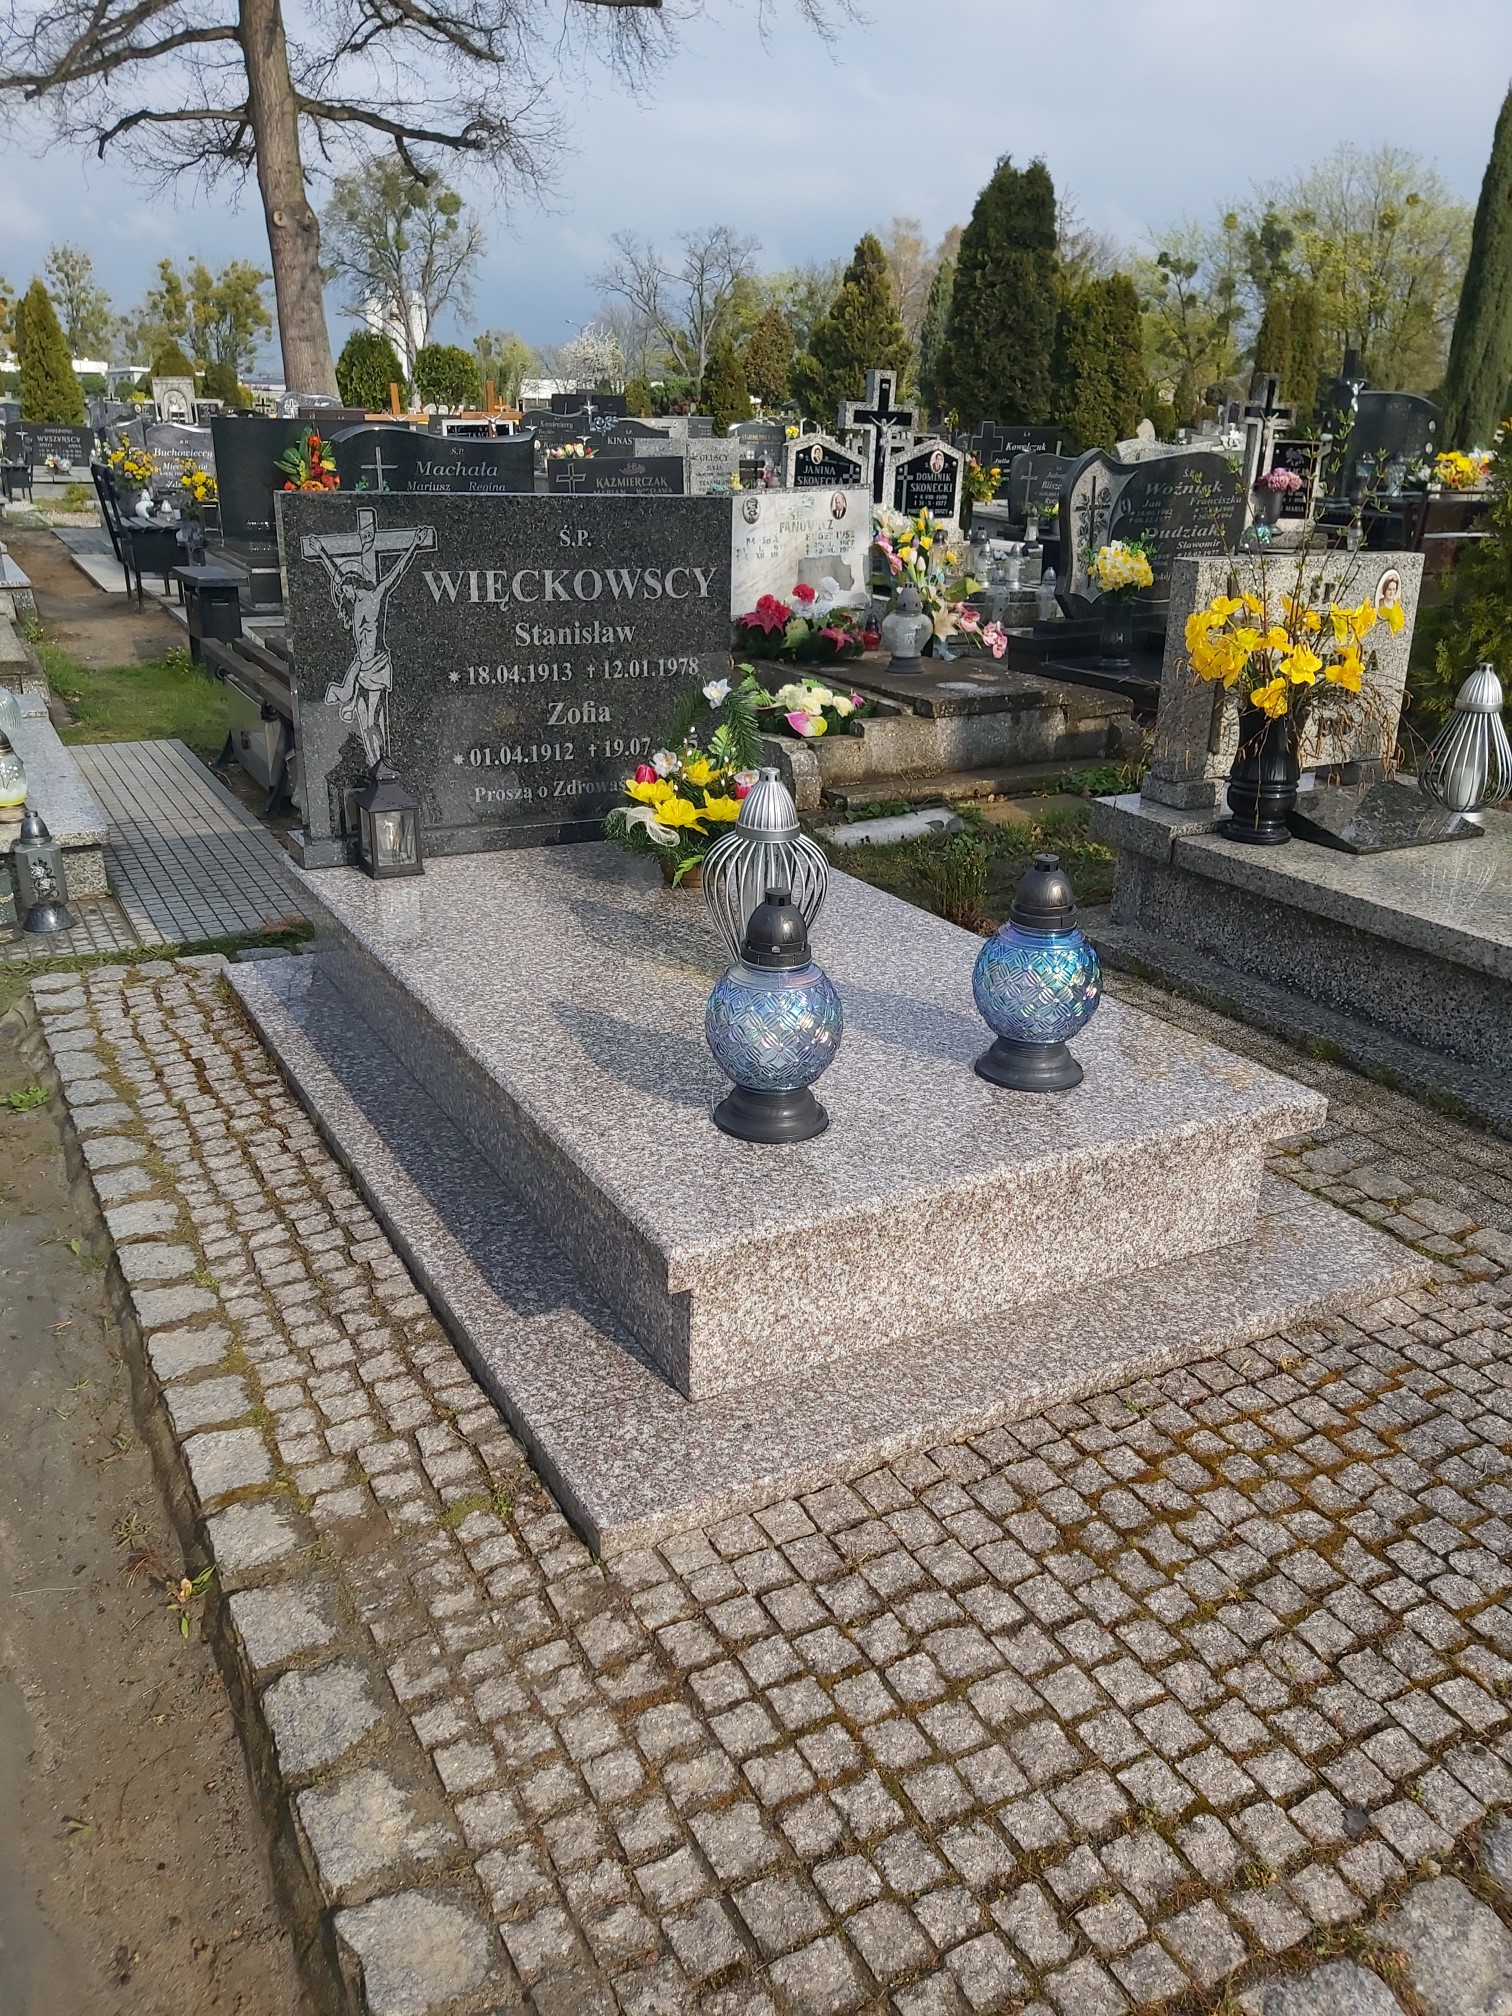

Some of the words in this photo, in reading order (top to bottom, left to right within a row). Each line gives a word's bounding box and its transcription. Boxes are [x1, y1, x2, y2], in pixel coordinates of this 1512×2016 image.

[608, 437, 635, 446] KINAS
[416, 461, 498, 477] Machała
[803, 465, 836, 475] JANINA
[797, 476, 844, 486] SKONECKA
[916, 472, 951, 482] DOMINIK
[407, 481, 451, 491] Mariusz
[469, 481, 506, 492] Regina
[910, 483, 953, 493] SKONECKI
[1146, 480, 1223, 496] Woźniak
[1143, 499, 1162, 508] Jan
[1189, 495, 1242, 506] Franciszka
[780, 520, 834, 533] FANOWZ
[1145, 524, 1219, 539] Dudziak
[560, 525, 592, 547] Ś.P.
[421, 567, 718, 612] WIĘCKOWSCY
[515, 621, 636, 647] Stanisław
[467, 662, 573, 686] 18.04.1913
[603, 657, 699, 680] 12.01.1978
[548, 700, 612, 726] Zofia
[470, 742, 575, 767] 01.04.1912
[475, 782, 533, 804] Proszą
[538, 787, 548, 798] o
[553, 777, 626, 798] Zdrowaś
